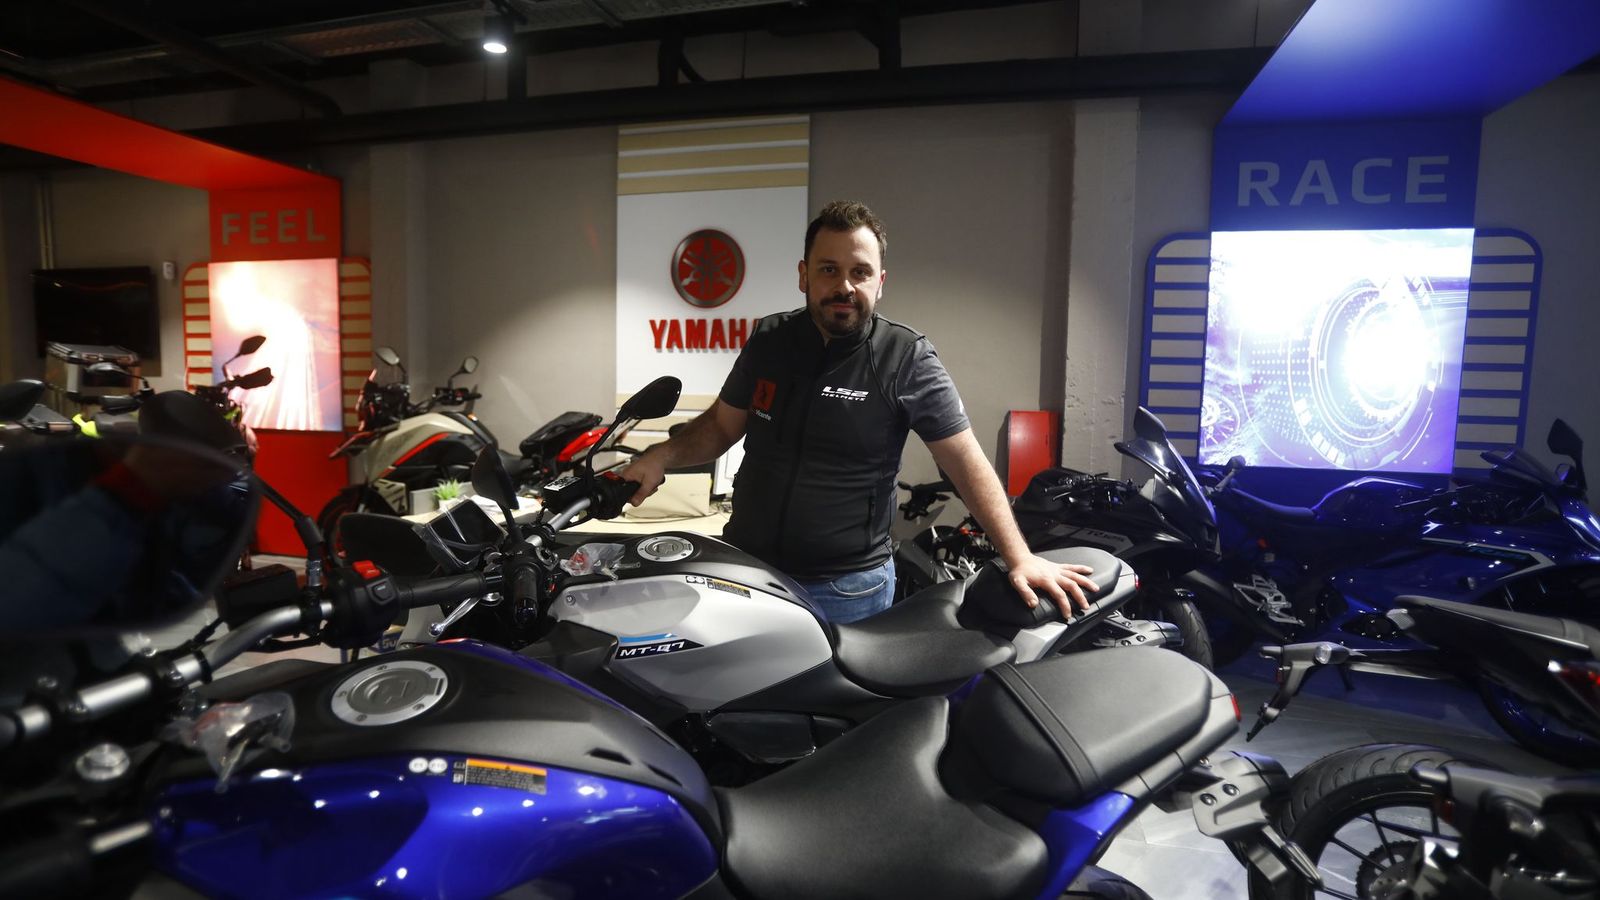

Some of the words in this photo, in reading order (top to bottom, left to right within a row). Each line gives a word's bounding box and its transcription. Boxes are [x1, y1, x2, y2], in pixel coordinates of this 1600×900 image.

[1236, 155, 1450, 207] RACE
[222, 208, 327, 246] FEEL
[649, 318, 760, 350] YAMAH
[821, 392, 866, 402] HELMETS
[822, 385, 870, 398] LS2
